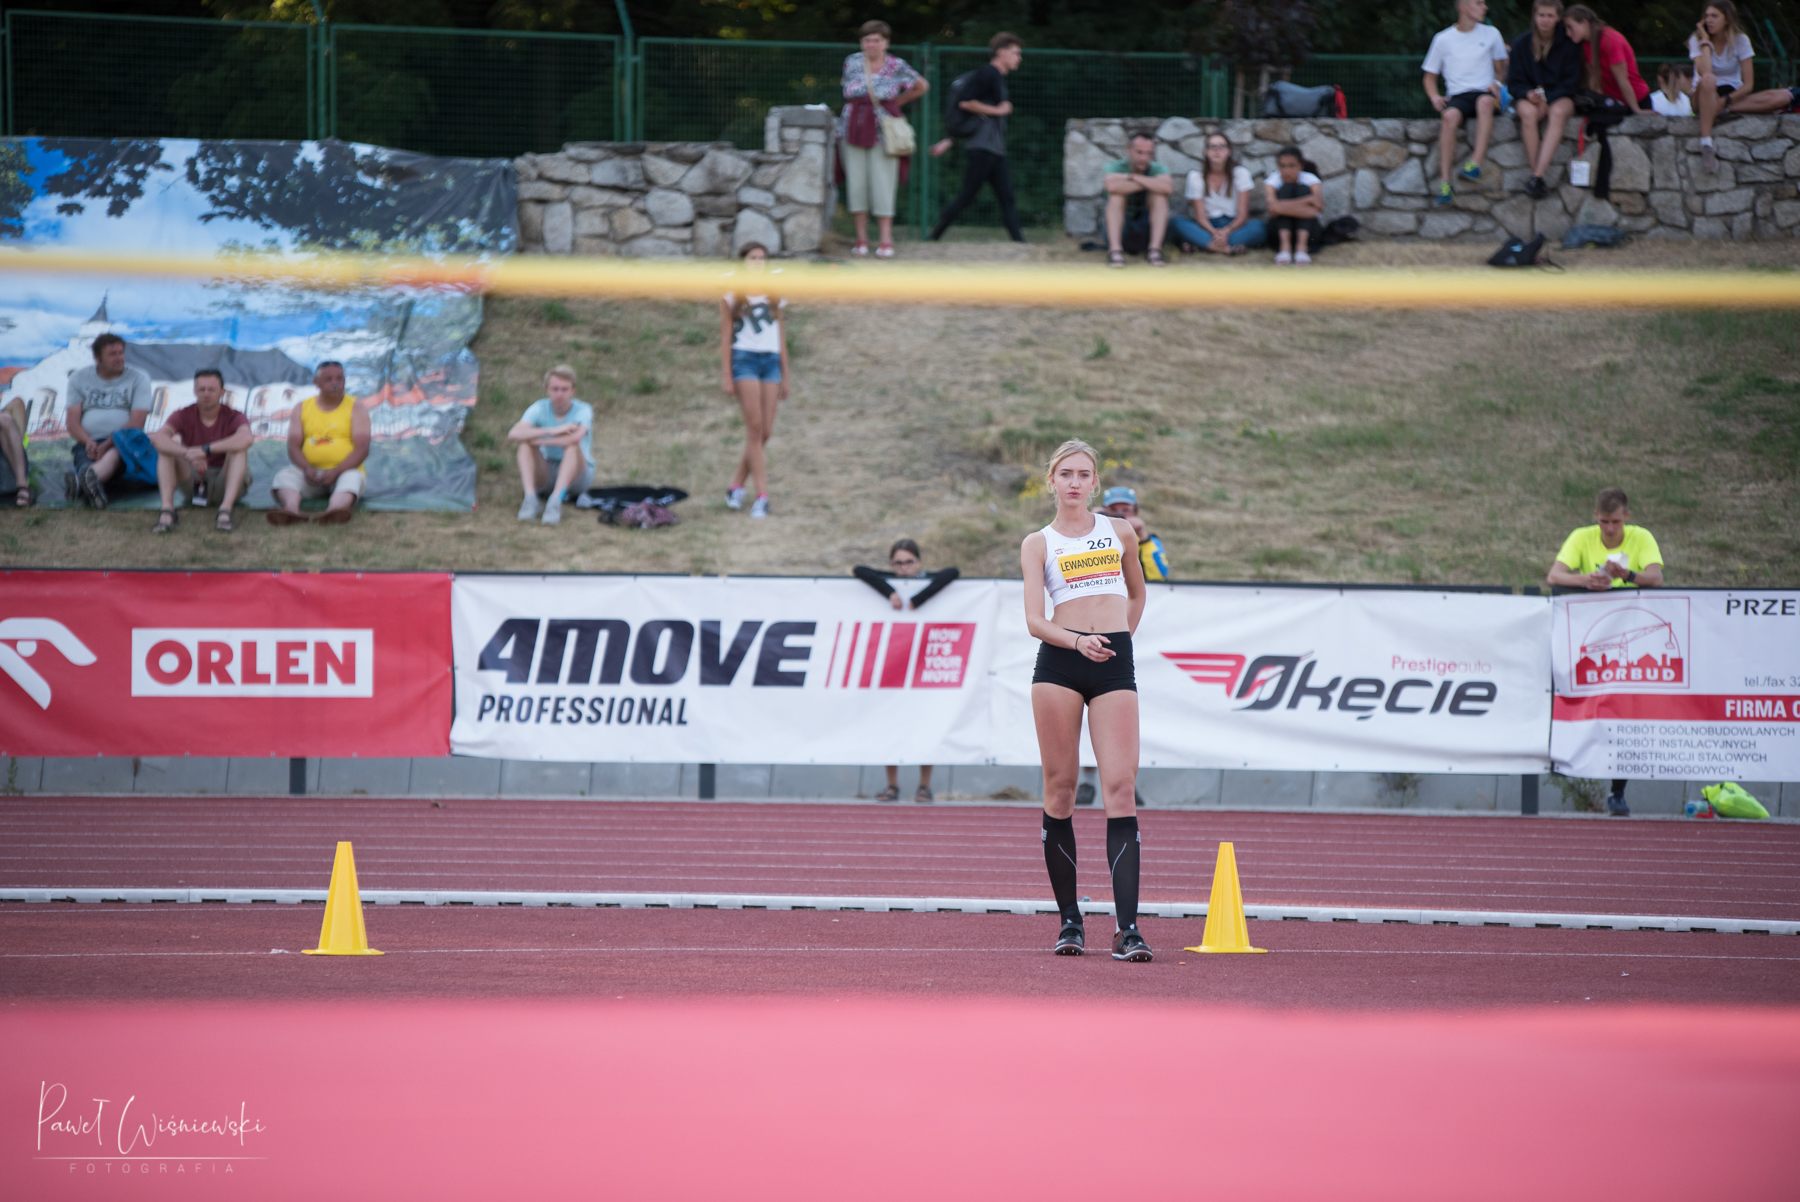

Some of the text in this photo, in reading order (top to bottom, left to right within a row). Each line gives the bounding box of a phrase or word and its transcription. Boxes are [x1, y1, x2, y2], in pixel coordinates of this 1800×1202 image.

[1087, 538, 1112, 550] 267
[1061, 554, 1120, 572] LEWANDOWSKA
[1069, 579, 1103, 589] RACIBÓRZ
[1104, 577, 1118, 585] 2019
[928, 628, 962, 642] NOW
[478, 618, 817, 688] 4MOVE
[925, 642, 953, 656] IT'S
[145, 640, 357, 686] ORLEN
[924, 656, 963, 669] YOUR
[921, 670, 961, 683] MOVE
[1585, 668, 1676, 683] BORBUD
[1744, 676, 1786, 688] tel./fax
[477, 695, 688, 726] PROFESSIONAL
[1725, 700, 1787, 718] FIRMA
[1616, 724, 1796, 737] ROBÓT OGÓLNOBUDOWLANYCH
[1616, 738, 1757, 750] ROBÓT INSTALACYJNYCH
[1616, 752, 1768, 763] KONSTRUKCJI STALOWYCH
[1616, 763, 1735, 776] ROBÓT DROGOWYCH
